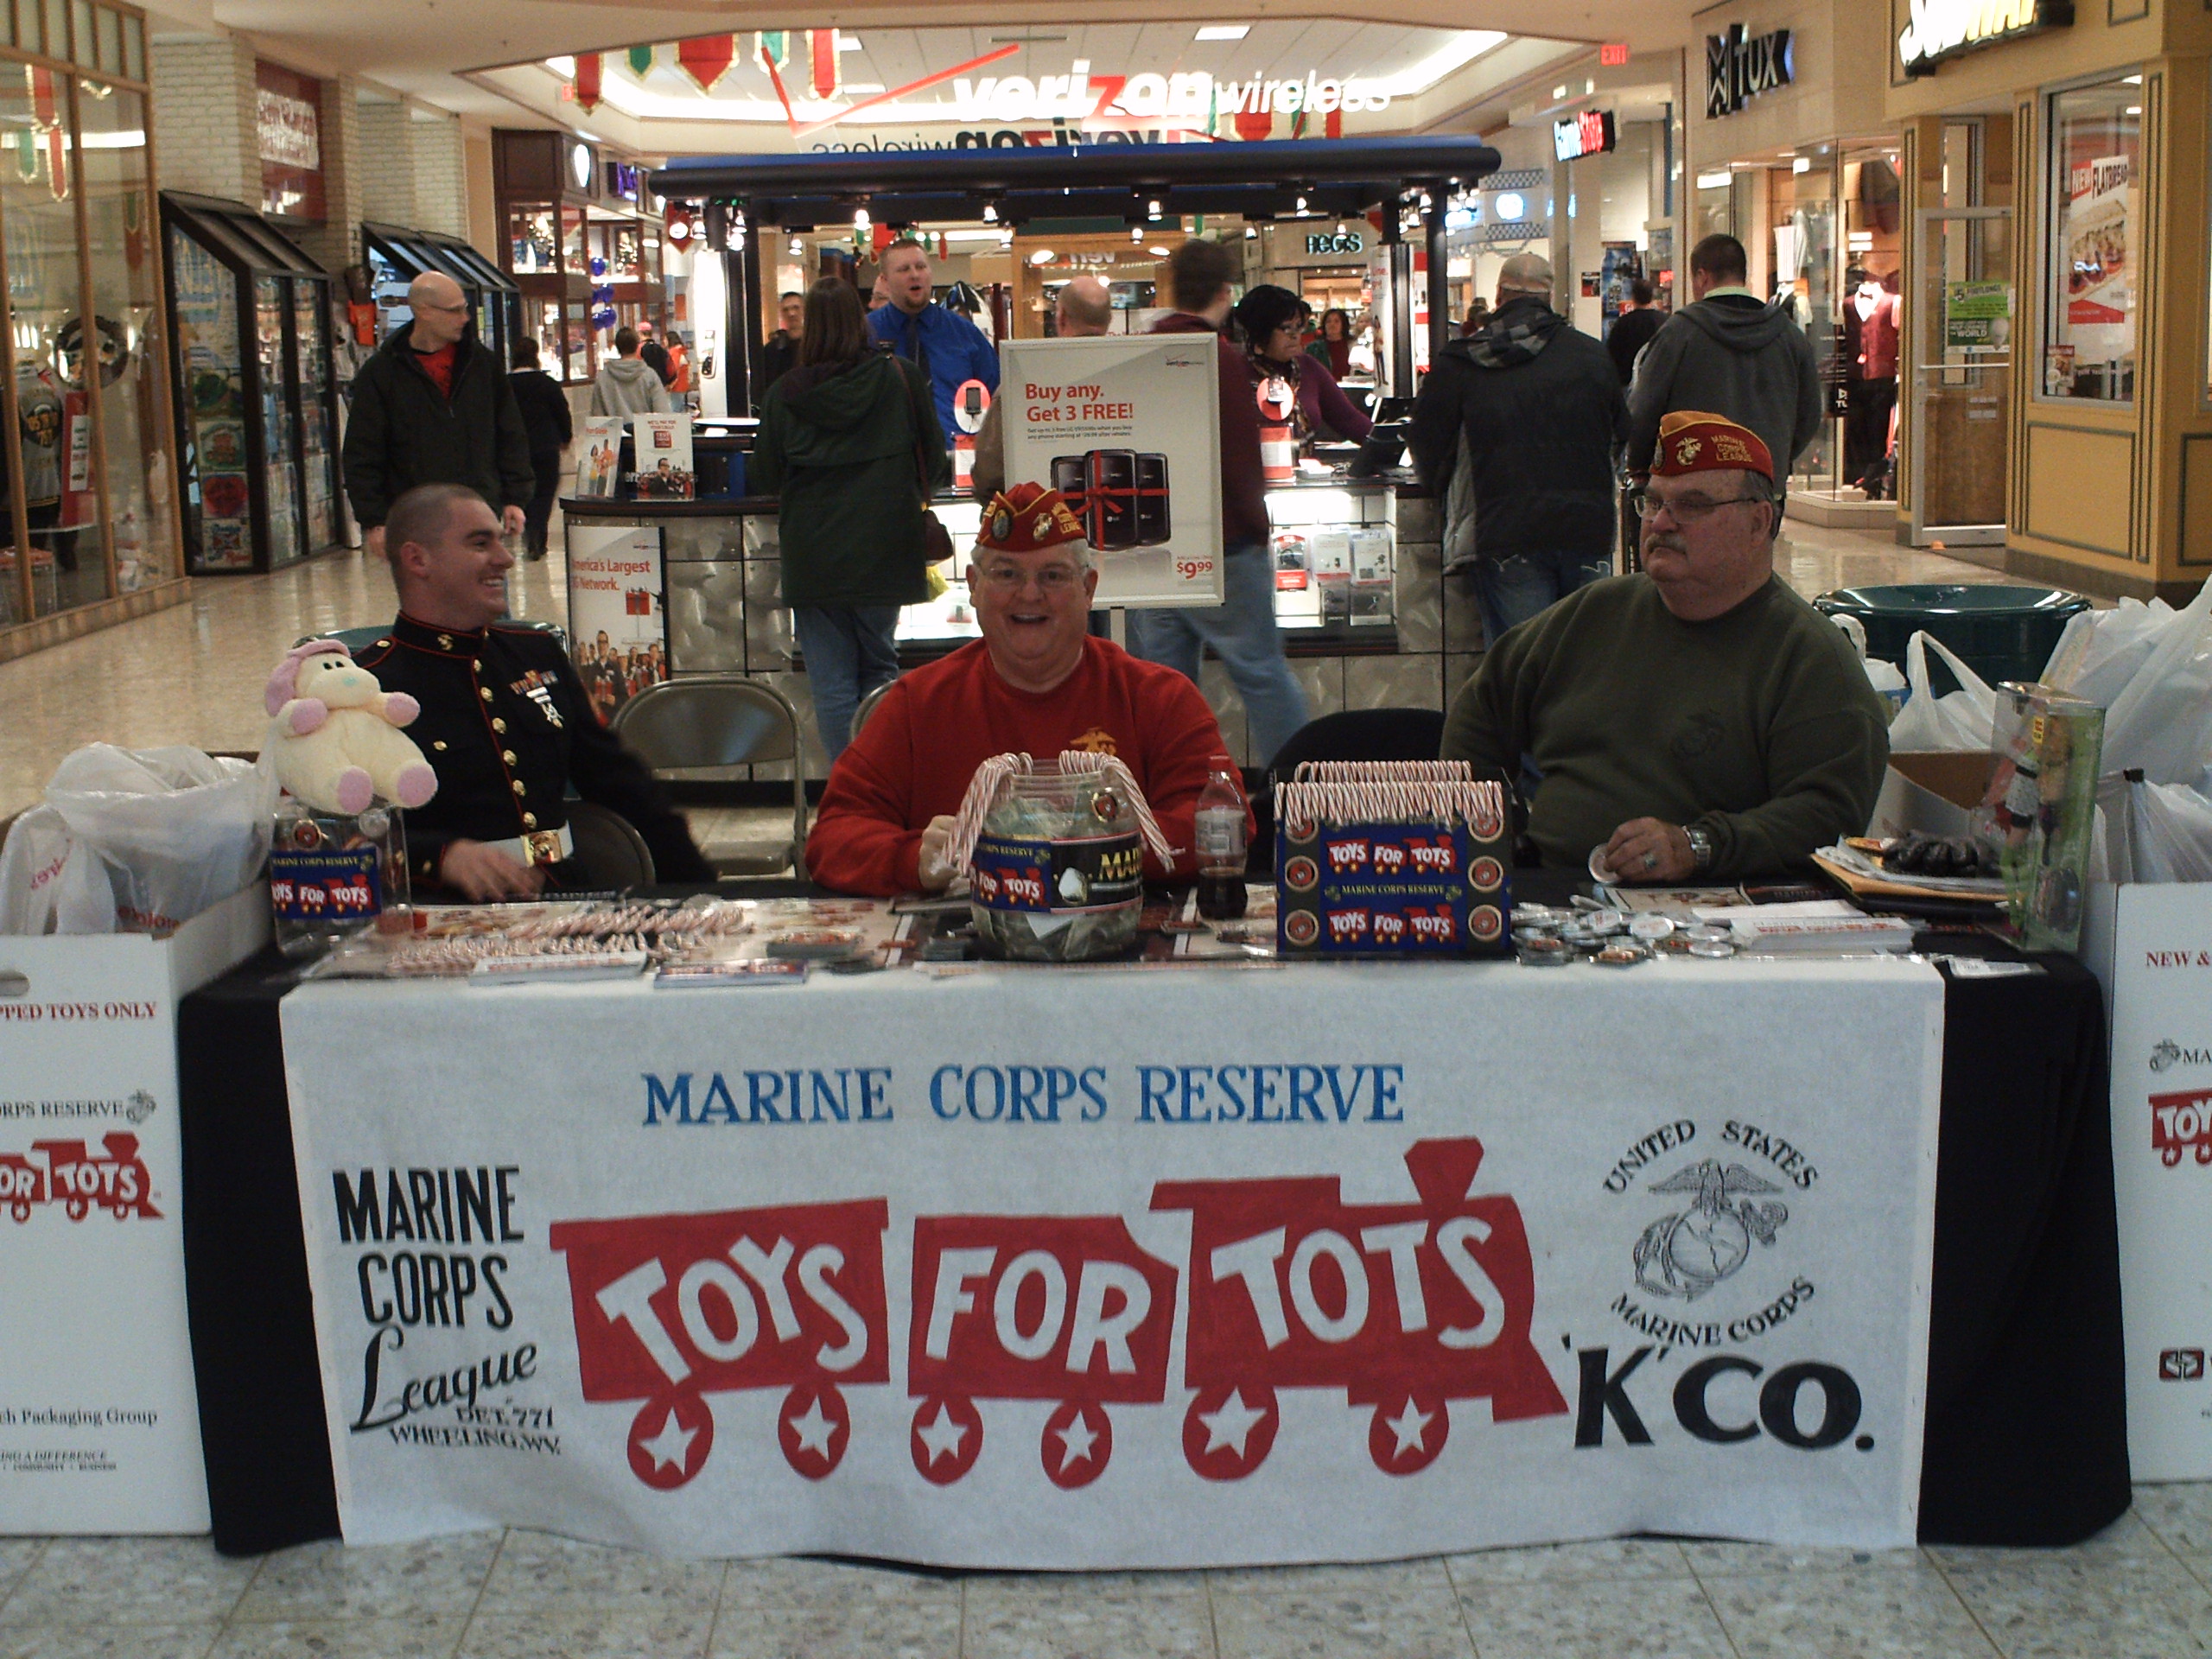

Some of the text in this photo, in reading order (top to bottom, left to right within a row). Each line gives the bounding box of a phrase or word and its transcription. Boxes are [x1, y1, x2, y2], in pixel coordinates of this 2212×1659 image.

[1601, 45, 1627, 64] EXIT
[952, 59, 1391, 131] verizon wireless
[1025, 384, 1104, 403] Buy any.
[1027, 403, 1135, 423] Get 3 FREE!
[607, 558, 651, 576] Largest
[326, 855, 359, 866] RESERVE
[1330, 842, 1451, 867] TOYS FOR TOTS
[300, 886, 326, 905] FOR
[332, 886, 369, 906] TOTS
[1003, 878, 1040, 900] TOTS
[1341, 884, 1445, 895] MARINE CORPS RESERVE
[1330, 911, 1451, 936] TOYS FOR TOTS
[2146, 951, 2209, 968] NEW &
[47, 1001, 99, 1020] TOYS
[104, 1001, 157, 1020] ONLY
[641, 1064, 1404, 1127] MARINE CORPS RESERVE
[41, 1100, 125, 1119] RESERVE
[1603, 1119, 1820, 1195] UNITED STATES
[54, 1162, 139, 1204] TOTS
[332, 1166, 524, 1244] MARINE
[358, 1249, 513, 1331] CORPS
[595, 1215, 1505, 1386] TOYS FOR TOTS
[1611, 1274, 1815, 1347] MARINE CORPS
[349, 1323, 537, 1434] League
[22, 1406, 103, 1427] Packaging
[106, 1408, 158, 1427] Group
[35, 1451, 107, 1462] DIFFERENCE
